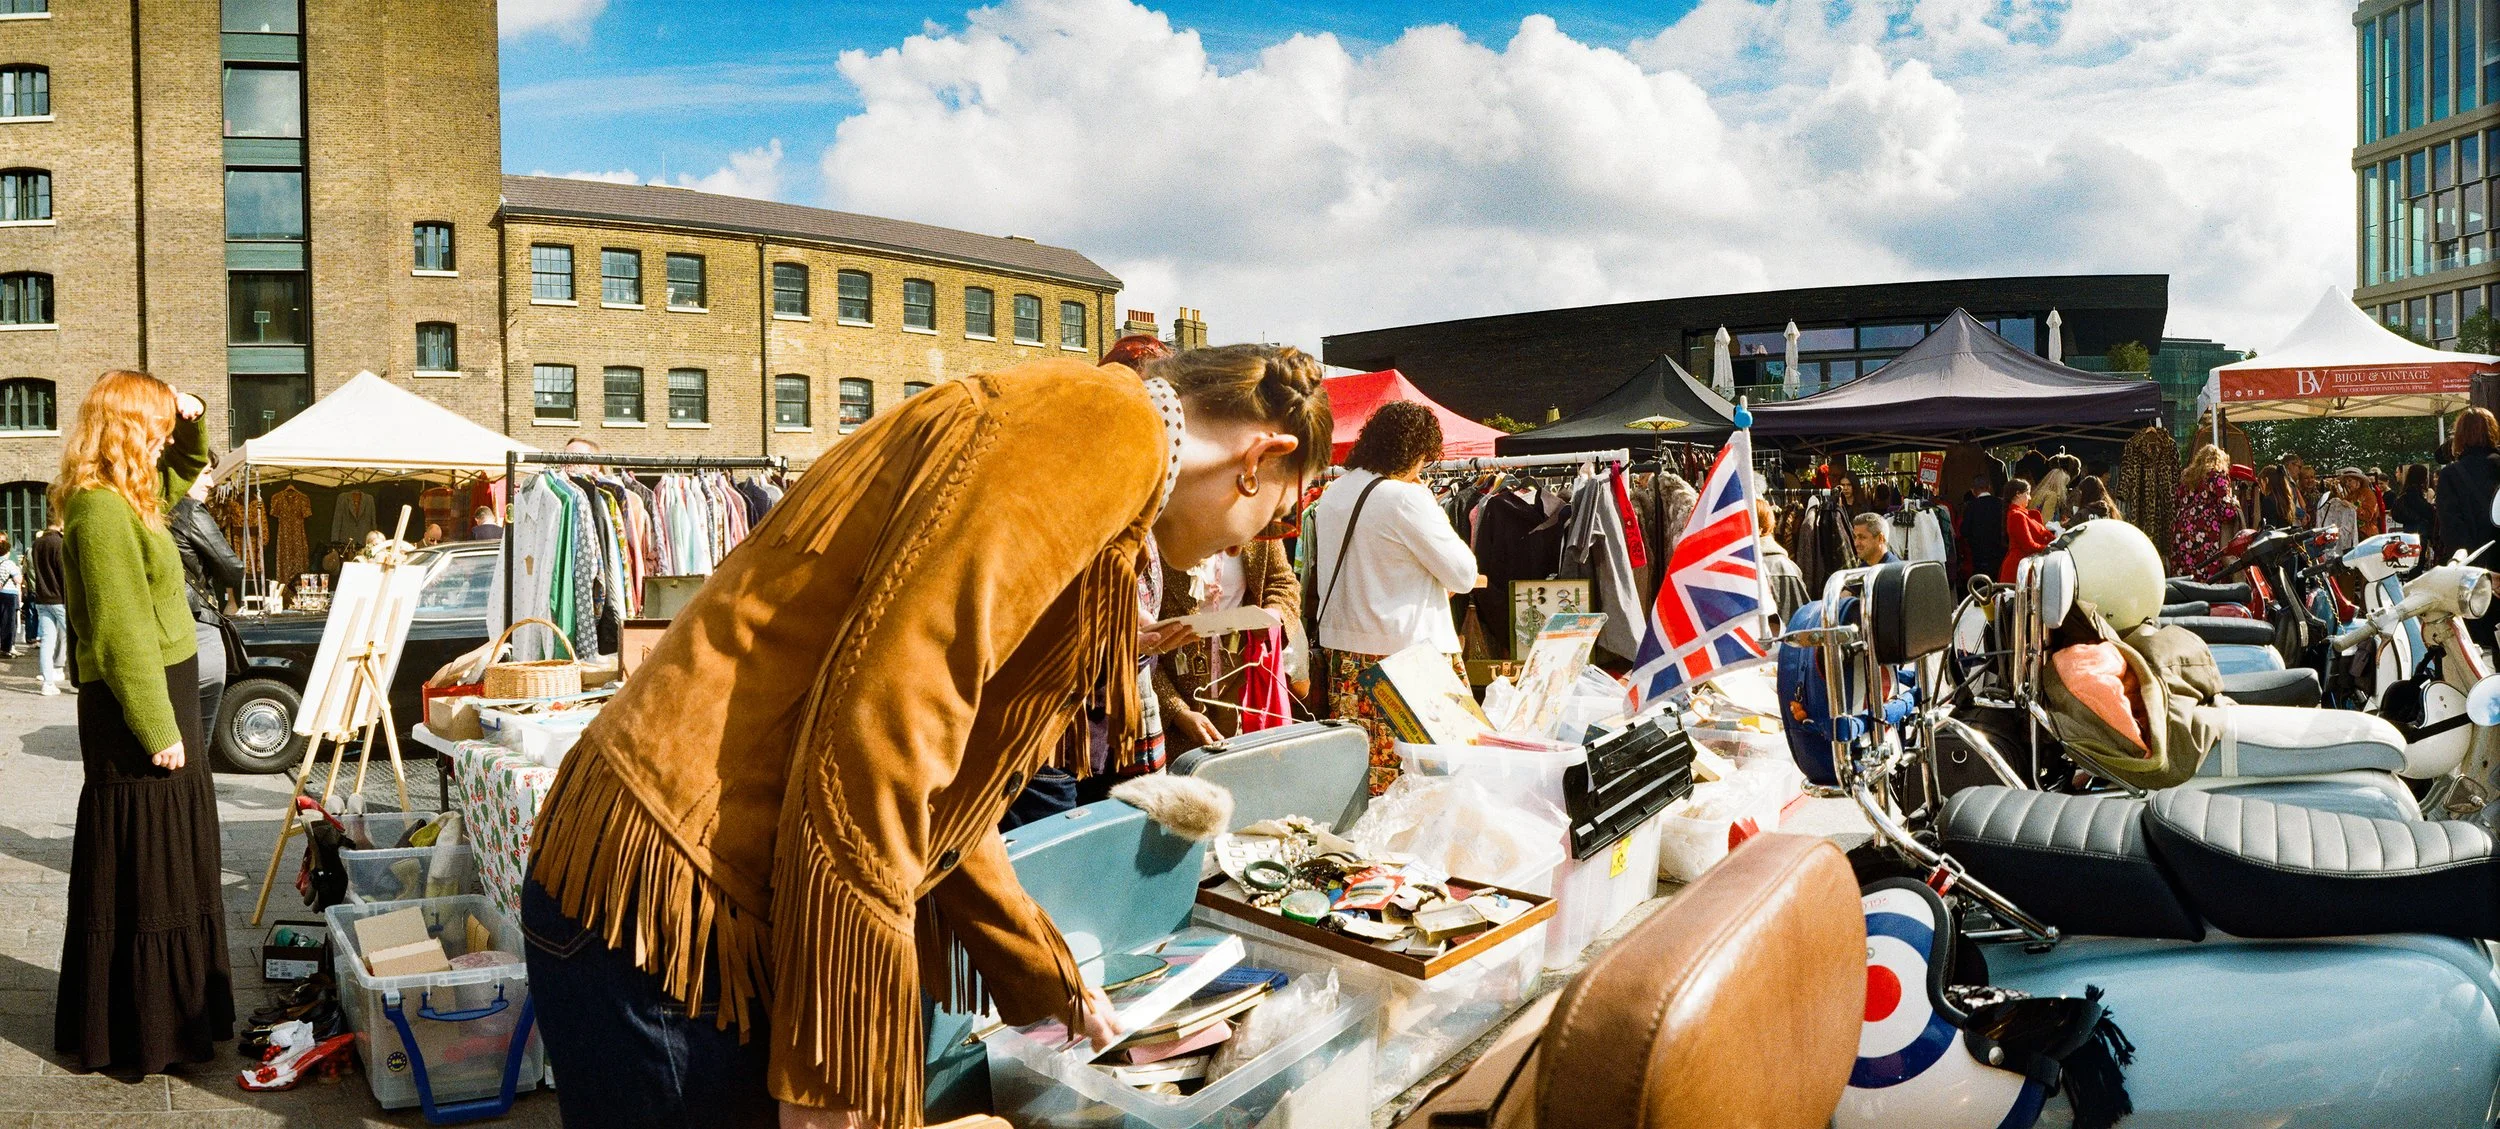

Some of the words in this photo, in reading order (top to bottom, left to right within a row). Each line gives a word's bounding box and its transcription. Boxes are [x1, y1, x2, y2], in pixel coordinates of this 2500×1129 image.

[2295, 369, 2329, 396] BV
[2335, 373, 2366, 384] BIJOU
[2368, 372, 2379, 382] &
[2380, 370, 2430, 381] VINTAGE
[1922, 457, 1939, 465] SALE
[1399, 711, 1418, 735] CUPBOARD
